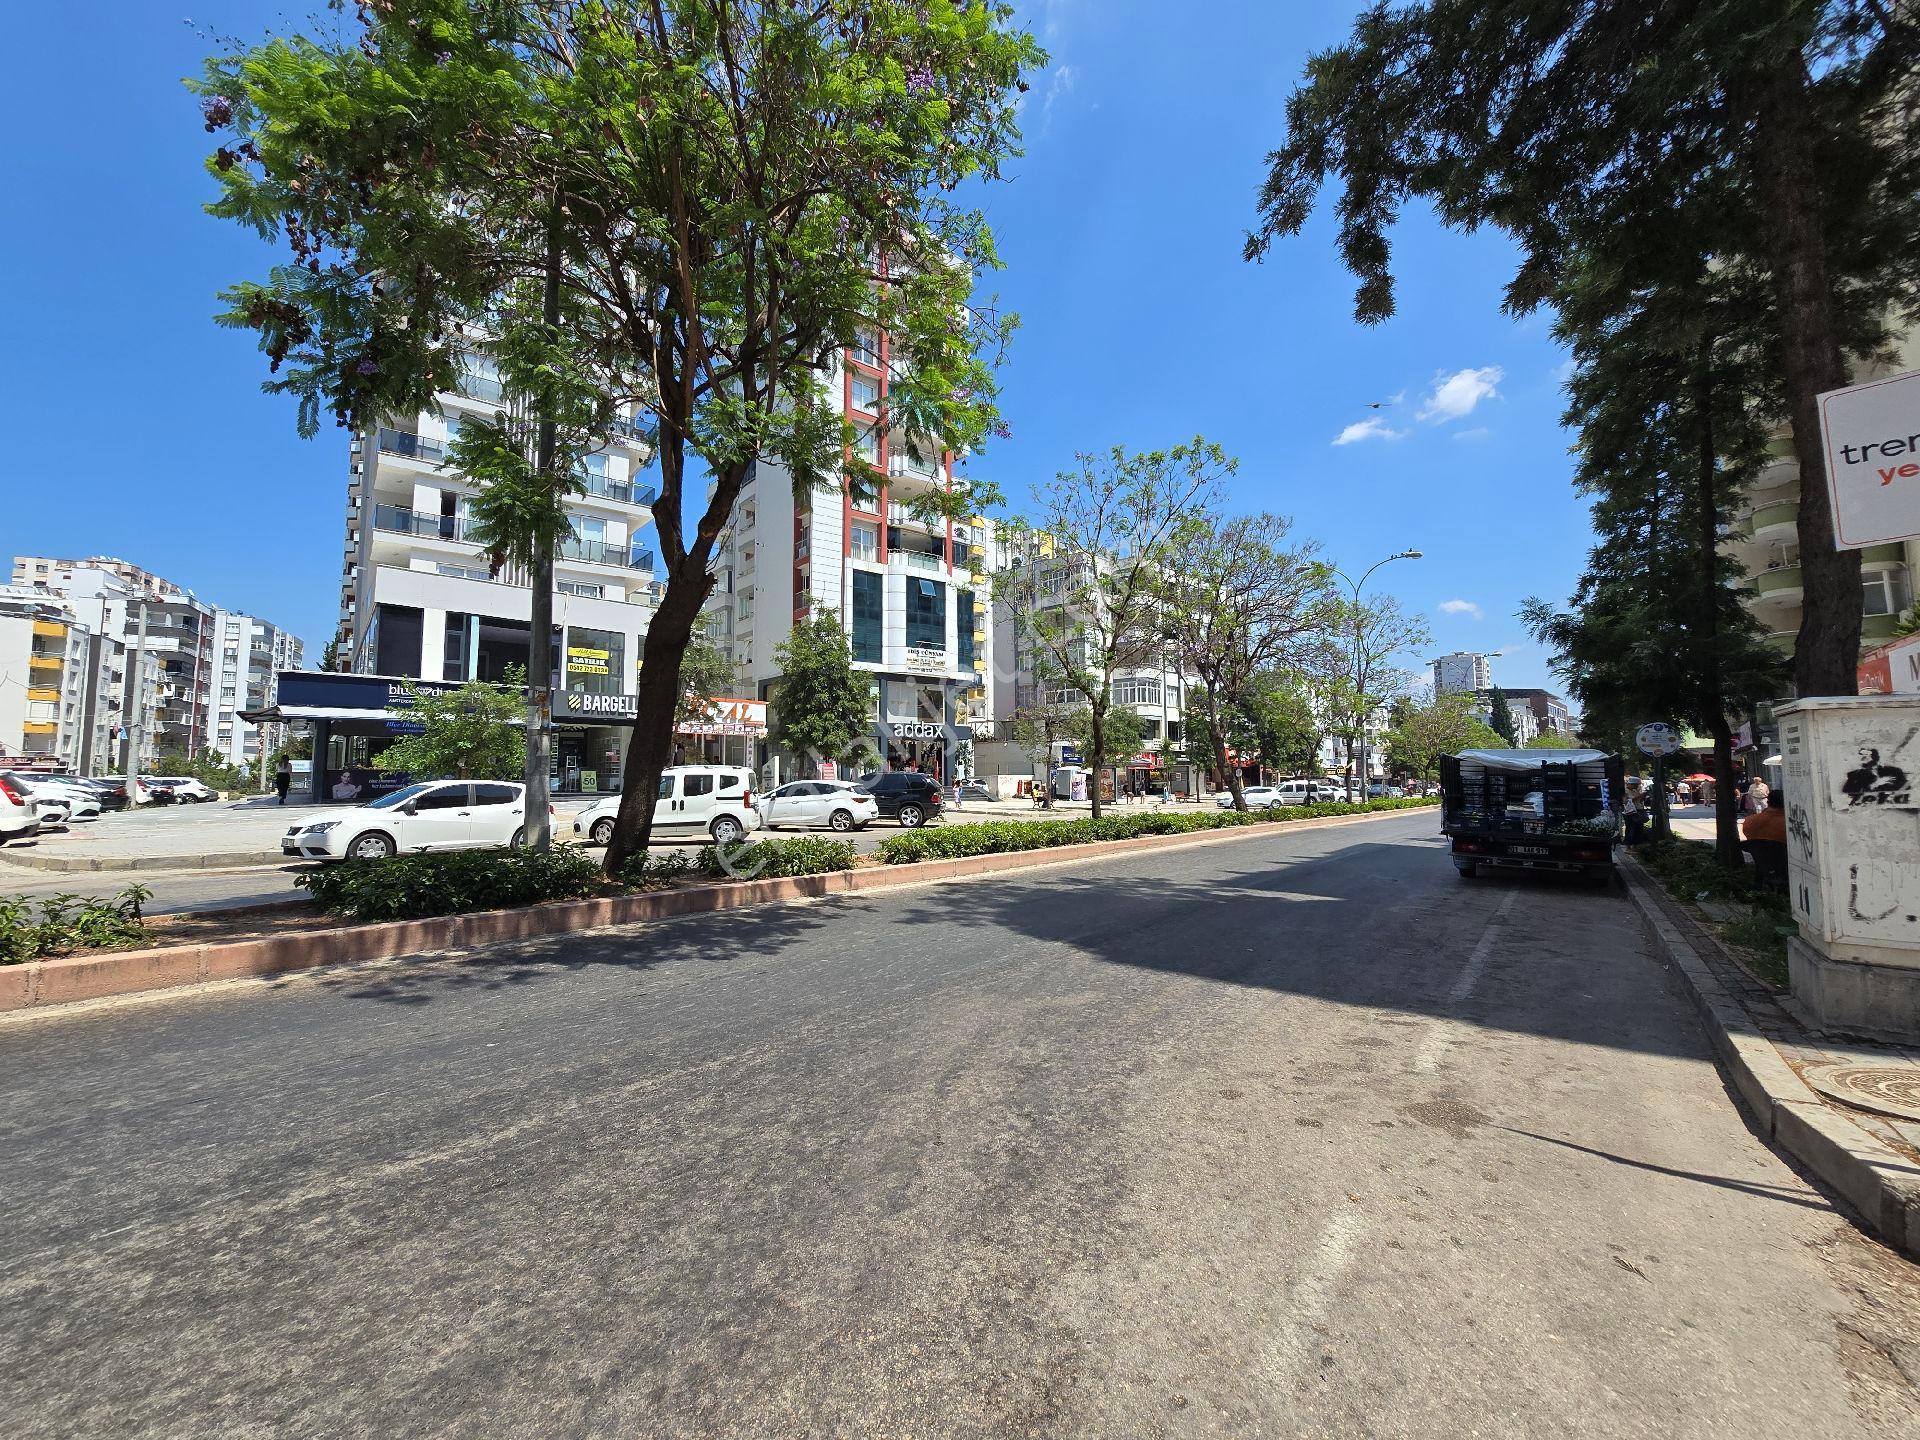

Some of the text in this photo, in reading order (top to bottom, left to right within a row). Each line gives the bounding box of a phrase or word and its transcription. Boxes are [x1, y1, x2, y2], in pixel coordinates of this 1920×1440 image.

[572, 657, 606, 666] SATILIK
[583, 694, 639, 713] BARGELL
[894, 721, 944, 738] addax
[583, 777, 595, 785] 50
